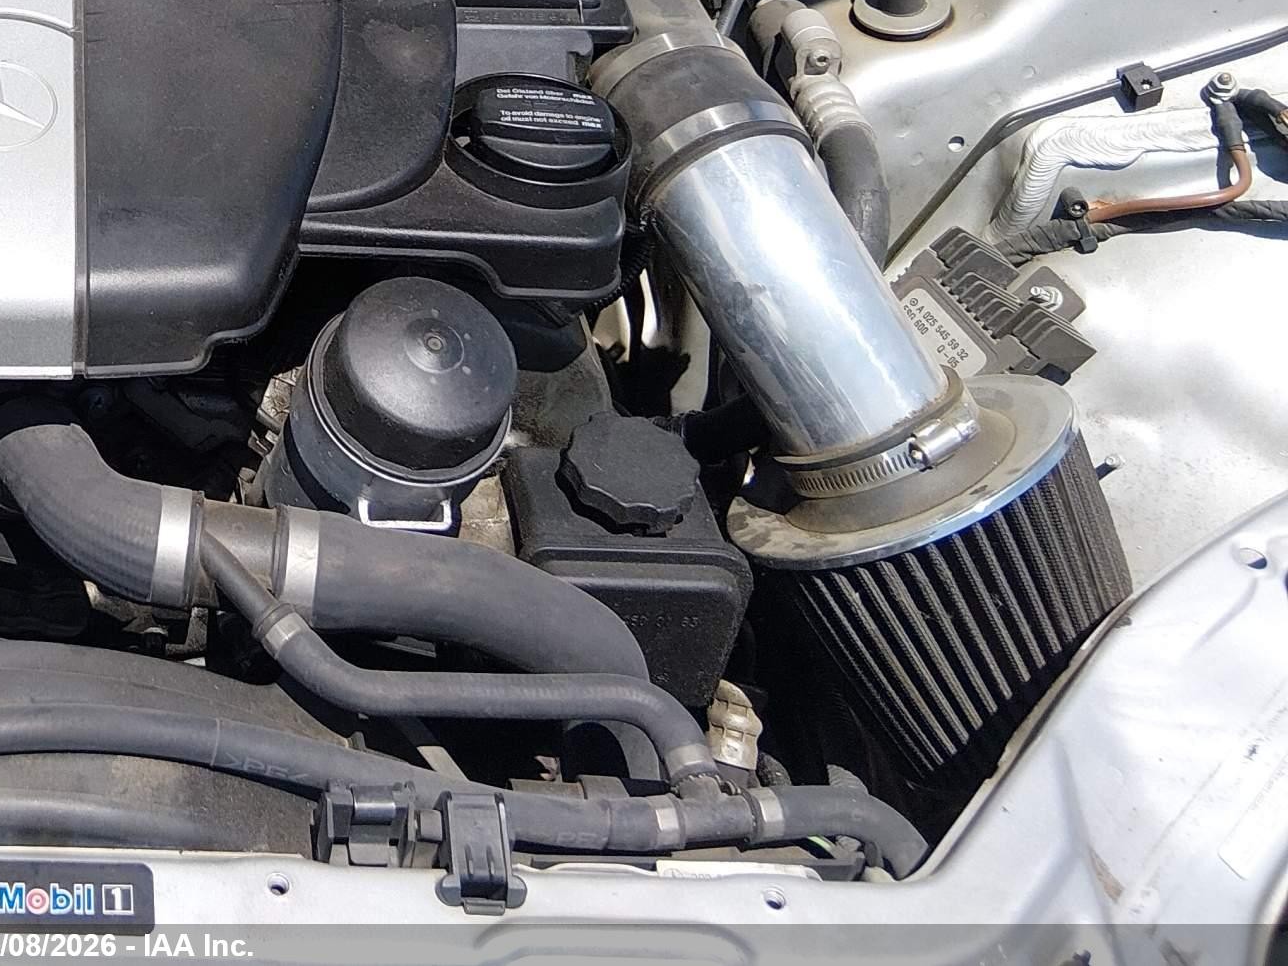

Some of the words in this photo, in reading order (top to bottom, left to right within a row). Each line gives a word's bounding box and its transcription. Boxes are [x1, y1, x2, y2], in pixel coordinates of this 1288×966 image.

[534, 111, 564, 119] damage
[581, 121, 602, 129] max
[916, 306, 925, 314] A
[923, 311, 938, 327] 025
[935, 325, 951, 341] 545
[947, 339, 960, 350] 59
[957, 348, 969, 361] 32
